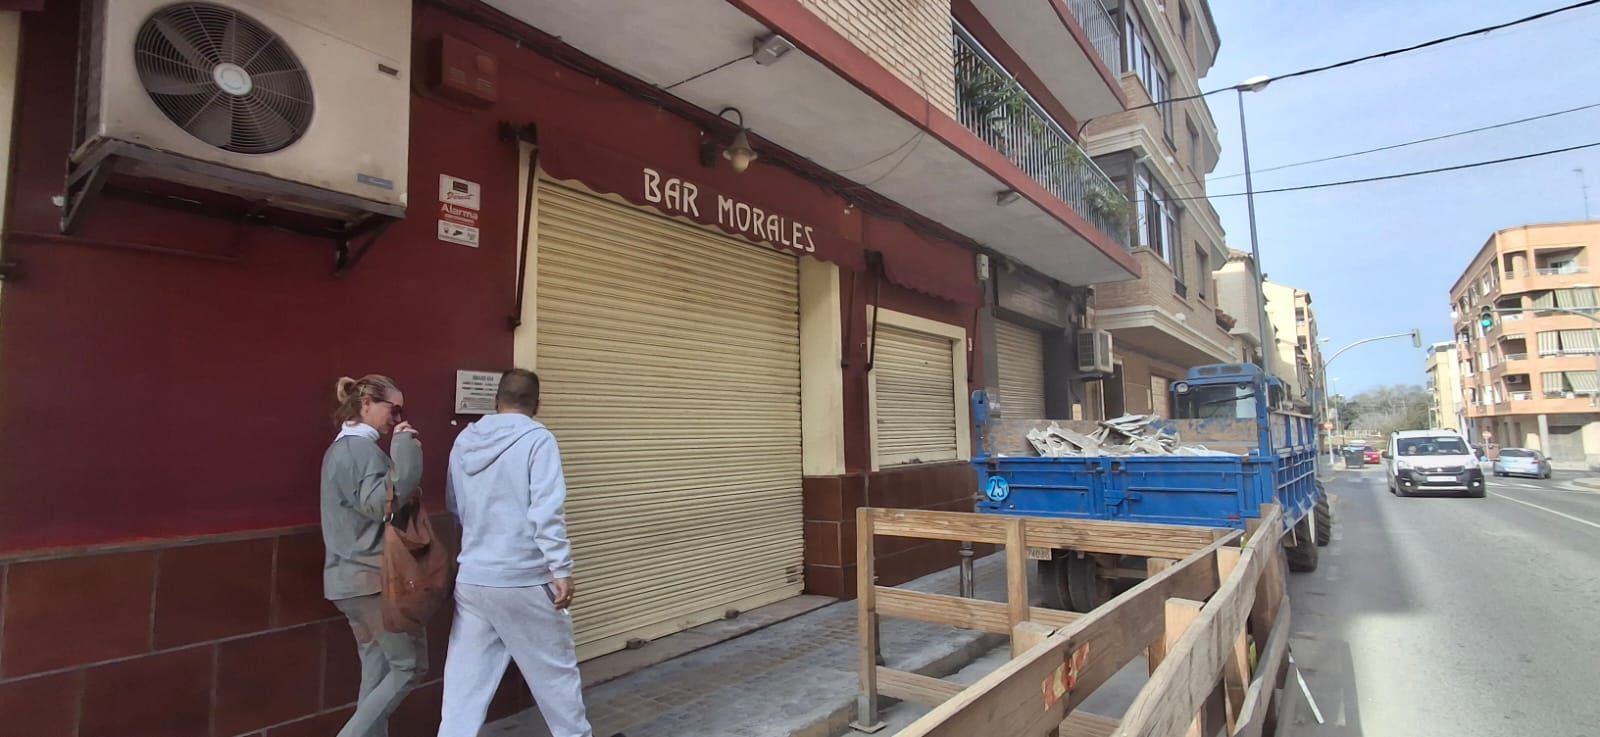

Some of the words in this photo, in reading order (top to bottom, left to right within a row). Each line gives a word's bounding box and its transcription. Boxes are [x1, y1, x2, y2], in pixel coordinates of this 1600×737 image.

[441, 203, 479, 220] Alarma
[643, 167, 699, 217] BAR
[718, 194, 816, 253] MORALES
[990, 478, 1005, 498] 25
